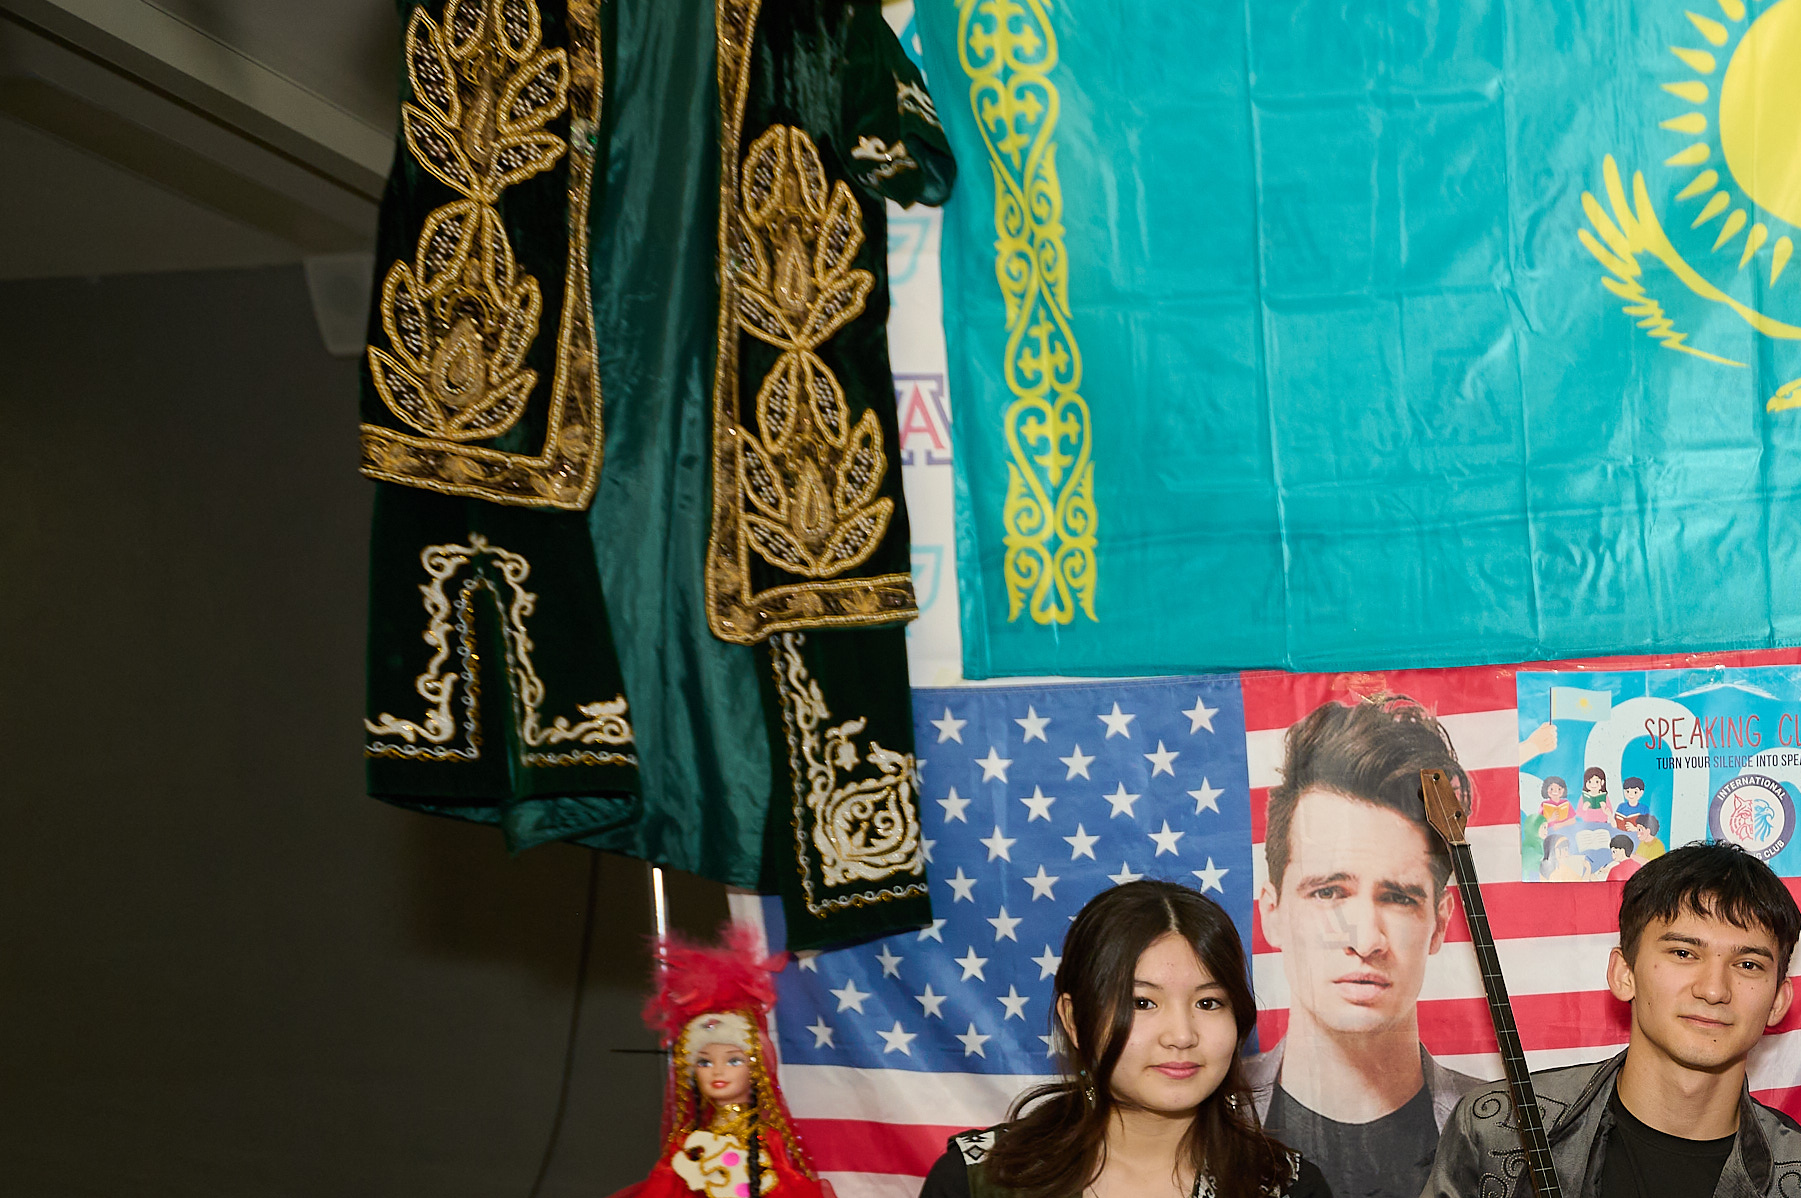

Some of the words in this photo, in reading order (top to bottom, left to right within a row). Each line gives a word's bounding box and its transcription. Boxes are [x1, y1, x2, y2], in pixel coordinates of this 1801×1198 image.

[1644, 714, 1762, 750] SPEAKING
[1656, 757, 1682, 770] TURN
[1684, 756, 1711, 769] YOUR
[1713, 755, 1754, 768] SILENCE
[1756, 754, 1779, 767] INTO
[1716, 776, 1786, 801] INTERNATIONAL
[1763, 840, 1785, 858] CLUB
